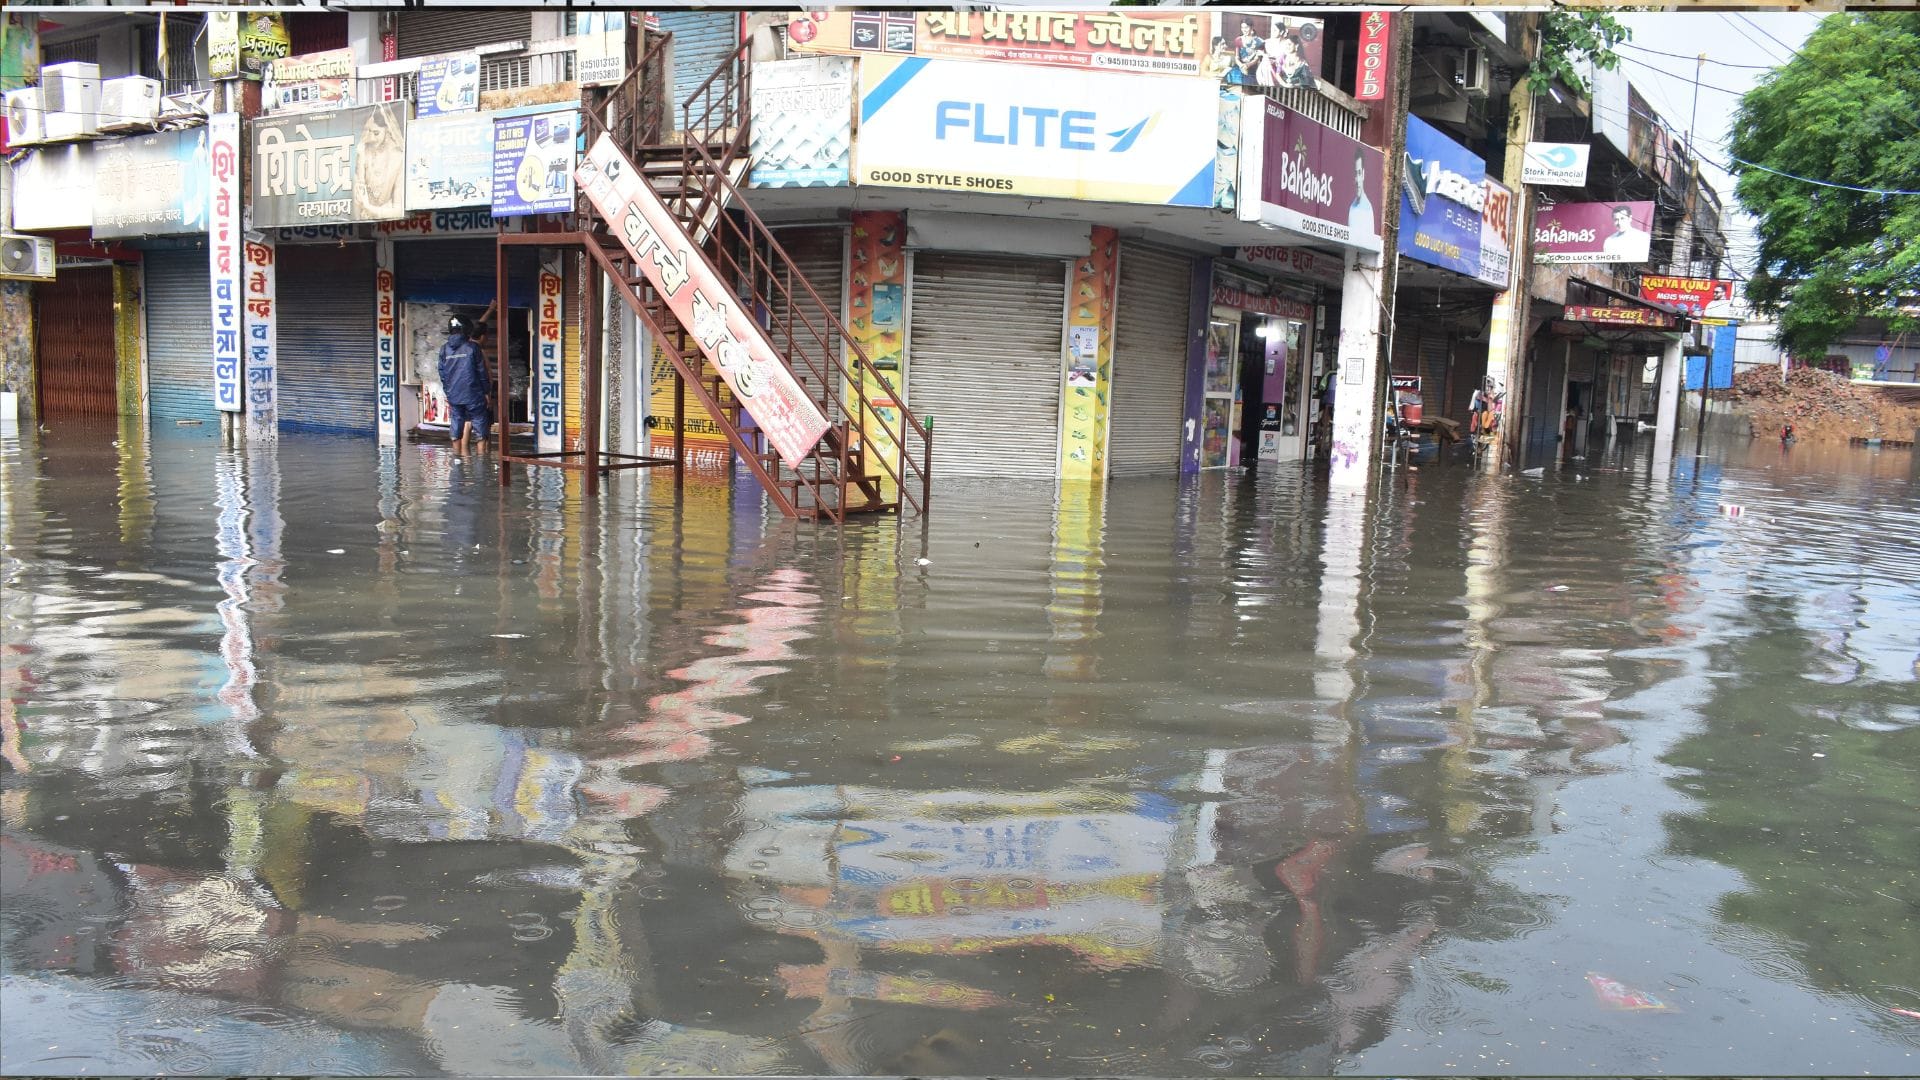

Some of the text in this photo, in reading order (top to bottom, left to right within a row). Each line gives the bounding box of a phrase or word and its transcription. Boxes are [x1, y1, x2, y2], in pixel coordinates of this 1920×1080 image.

[982, 12, 1079, 44] प्रसाद
[1084, 12, 1199, 53] ज्वेलर्स
[580, 57, 620, 70] 9451013133
[1107, 57, 1150, 68] 9451013133
[1362, 42, 1382, 96] GOLD
[935, 101, 1097, 151] FLITE
[257, 123, 355, 197] शिवेन्द्र
[870, 170, 1014, 190] GOOD STYLE SHOES
[1280, 150, 1334, 207] Bahamas
[1524, 167, 1584, 178] Stork Financial
[297, 198, 353, 218] वस्त्रालय
[1301, 218, 1350, 241] GOOD STYLE SHOES
[1534, 226, 1596, 243] Bahamas
[1642, 277, 1712, 293] KAVYA KUNJ
[1245, 293, 1272, 313] LUCK
[1275, 295, 1306, 317] SHOES
[1656, 292, 1678, 301] MENS
[1591, 308, 1645, 324] वर-वधू
